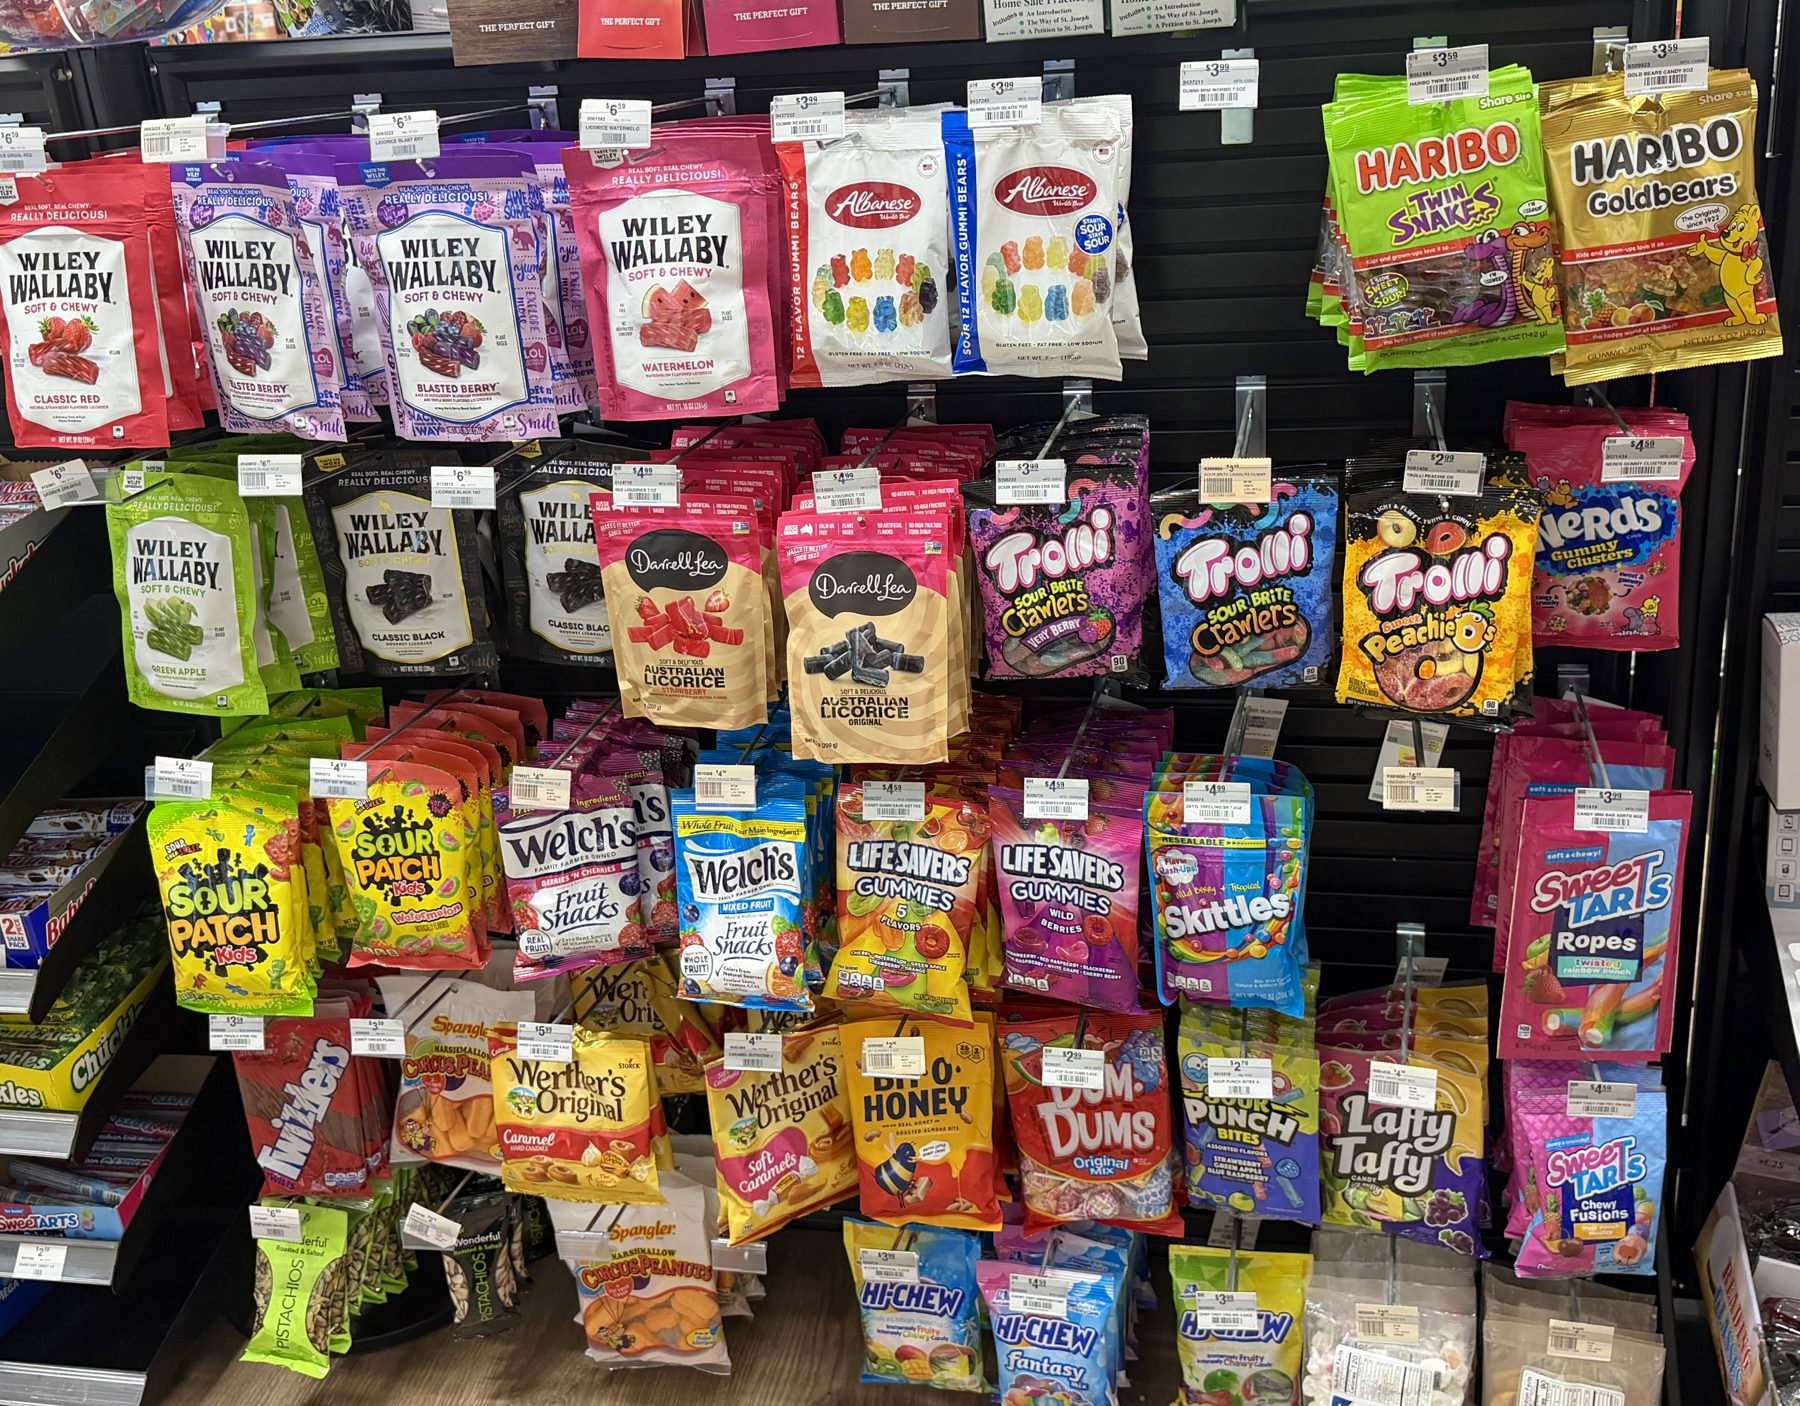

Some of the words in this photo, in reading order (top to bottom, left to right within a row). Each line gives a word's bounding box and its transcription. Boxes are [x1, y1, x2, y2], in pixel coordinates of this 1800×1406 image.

[734, 12, 750, 22] THE
[751, 9, 788, 20] PERFECT
[789, 7, 808, 16] GIFT
[872, 2, 890, 10] THE
[891, 0, 926, 10] PERFECT
[927, 0, 948, 9] GIFT
[1198, 8, 1219, 18] Joseph
[479, 24, 497, 32] THE
[498, 22, 534, 32] PERFECT
[535, 20, 556, 30] GIFT
[600, 18, 613, 26] THE
[614, 18, 644, 26] PERFECT
[644, 18, 661, 26] GIFT
[1162, 20, 1184, 28] Petition
[1202, 17, 1222, 27] Joseph
[1356, 124, 1518, 193] HARIBO
[1573, 118, 1740, 184] HARIBO
[956, 157, 968, 202] BEARS
[1003, 175, 1090, 204] Albanese
[790, 182, 800, 228] BEARS
[832, 190, 914, 218] Albanese
[1408, 182, 1465, 212] TWIN
[1588, 174, 1736, 216] Goldbears
[10, 210, 45, 222] REALLY
[47, 210, 108, 221] DELICIOUS!
[622, 214, 713, 238] WILEY
[1387, 182, 1501, 245] SNAKES
[957, 204, 970, 261] GUMMI
[1080, 222, 1106, 234] SOUR
[204, 239, 276, 261] WILEY
[400, 237, 481, 258] WILEY
[611, 235, 728, 272] WALLABY
[1084, 235, 1110, 251] SOUR
[16, 252, 101, 272] WILEY
[628, 269, 655, 282] SOFT
[659, 267, 666, 277] &
[669, 266, 712, 278] CHEWY
[790, 242, 802, 288] GUMMI
[10, 271, 114, 307] WALLABY
[198, 260, 292, 295] WALLABY
[388, 260, 497, 294] WALLABY
[960, 264, 971, 312] FLAVOR
[404, 291, 429, 303] SOFT
[432, 292, 440, 300] &
[442, 290, 484, 303] CHEWY
[793, 290, 804, 342] FLAVOR
[961, 312, 971, 329] 12
[796, 344, 806, 360] 12
[962, 330, 973, 356] SOUR
[642, 358, 714, 372] WATERMELON
[34, 394, 78, 404] CLASSIC
[79, 394, 100, 404] RED
[417, 382, 459, 394] BLASTED
[460, 382, 498, 393] BERRY
[132, 501, 161, 512] REALLY
[162, 500, 218, 512] DELICIOUS!
[350, 512, 428, 532] WILEY
[136, 538, 208, 559] WILEY
[986, 507, 1110, 592] Trolli
[1178, 512, 1310, 602] Trolli
[1551, 540, 1618, 561] Gummy
[133, 557, 220, 590] WALLABY
[630, 549, 694, 574] Darrell
[688, 550, 724, 576] Lea
[1364, 536, 1507, 612] Trolli
[816, 573, 882, 600] Darrell
[877, 574, 912, 601] Lea
[1014, 588, 1047, 609] SOUR
[1002, 592, 1088, 637] Crawlers
[1208, 599, 1248, 625] SOUR
[372, 632, 410, 642] CLASSIC
[412, 630, 446, 640] BLACK
[1192, 604, 1298, 656] Crawlers
[152, 664, 176, 676] GREEN
[178, 666, 207, 677] APPLE
[644, 664, 724, 676] AUSTRALIAN
[1113, 656, 1125, 666] 90
[644, 675, 726, 688] LICORICE
[820, 696, 909, 706] AUSTRALIAN
[820, 706, 910, 719] LICORICE
[848, 718, 882, 726] ORIGINAL
[682, 820, 712, 830] Whole
[714, 820, 734, 831] Fruit
[356, 829, 433, 857] SOUR
[506, 815, 637, 869] Welch's
[1162, 836, 1225, 846] RESEALABLE
[356, 856, 440, 885] PATCH
[690, 846, 794, 896] Welch's
[849, 842, 896, 870] LIFE
[896, 842, 970, 884] SAVERS
[1002, 846, 1048, 876] LIFE
[1047, 847, 1124, 891] SAVERS
[170, 879, 268, 917] SOUR
[392, 881, 426, 896] Kids
[556, 883, 609, 912] Fruit
[856, 878, 954, 911] GUMMIES
[1011, 882, 1110, 915] GUMMIES
[392, 902, 462, 925] Watermelon
[542, 900, 619, 931] Snacks
[722, 902, 748, 912] MIXED
[750, 899, 772, 910] FRUIT
[896, 904, 907, 918] 5
[1049, 908, 1074, 921] WILD
[1166, 894, 1290, 939] Skittles
[171, 912, 278, 951] PATCH
[725, 920, 768, 940] Fruit
[880, 916, 922, 932] FLAVORS
[524, 943, 550, 954] FRUIT!
[526, 936, 545, 945] REAL
[712, 936, 774, 957] Snacks
[1556, 931, 1637, 954] Ropes
[214, 945, 258, 964] Kids
[684, 956, 709, 965] WHOLE
[1576, 959, 1621, 968] twisted
[684, 964, 710, 974] FRUIT!
[506, 1058, 626, 1097] Werther's
[726, 1054, 838, 1119] Werther's
[536, 1091, 625, 1123] Original
[757, 1076, 840, 1130] Original
[864, 1086, 968, 1122] HONEY
[1036, 1101, 1155, 1157] DUMS
[1184, 1098, 1298, 1144] PUNCH
[1218, 1128, 1260, 1146] BITES
[738, 1152, 798, 1193] Caramels
[748, 1150, 774, 1178] Soft
[1072, 1156, 1130, 1171] Original
[1352, 1174, 1378, 1184] CANDY
[1570, 1208, 1629, 1222] Fusions
[472, 1252, 490, 1322] PISTACHIOS
[276, 1258, 305, 1350] PISTACHIOS
[861, 1282, 963, 1318] HI-CHEW
[996, 1314, 1098, 1357] HI-CHEW
[1006, 1352, 1086, 1382] fantasy
